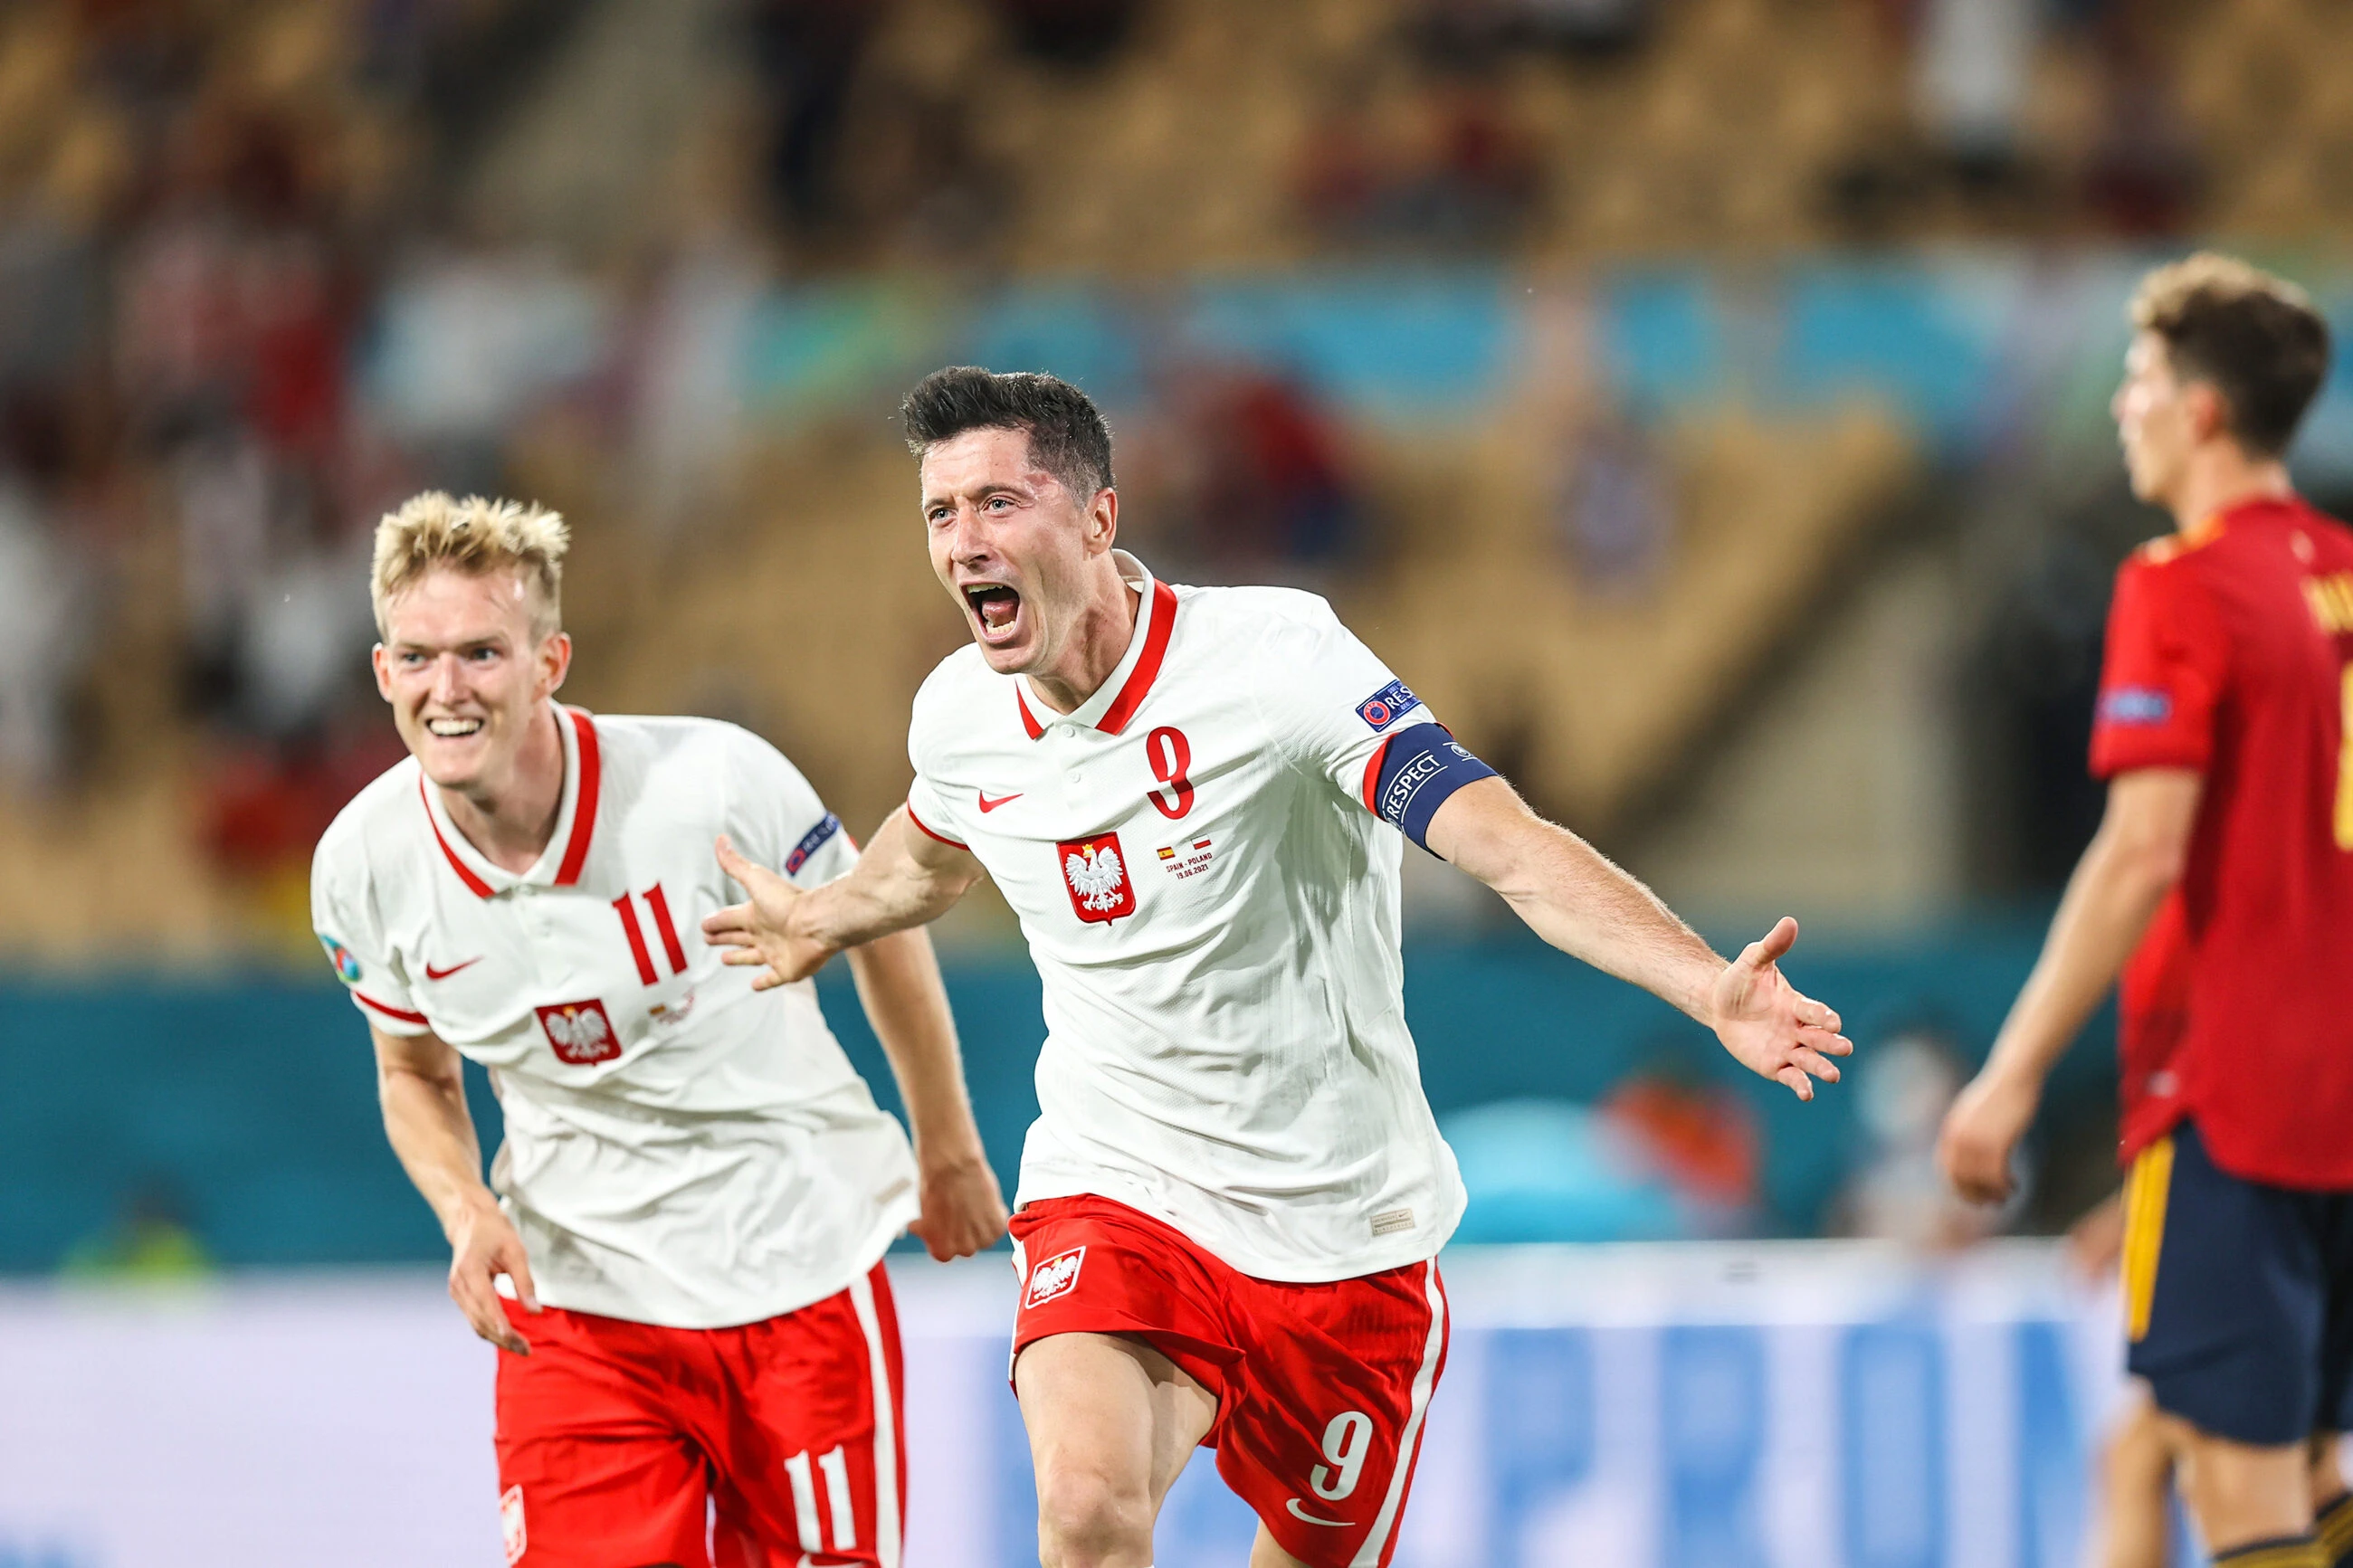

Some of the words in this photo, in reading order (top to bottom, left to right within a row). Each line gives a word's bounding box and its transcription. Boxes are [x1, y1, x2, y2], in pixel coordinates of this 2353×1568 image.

[1385, 686, 1413, 709] RES
[1146, 726, 1195, 820] 9
[1386, 755, 1440, 820] RESPECT
[1166, 862, 1184, 873] SPAIN
[1187, 852, 1213, 866] POLAND
[1176, 863, 1209, 879] 19.06.2021
[612, 882, 688, 986] 11
[1310, 1411, 1374, 1501] 9
[783, 1443, 857, 1554] 11
